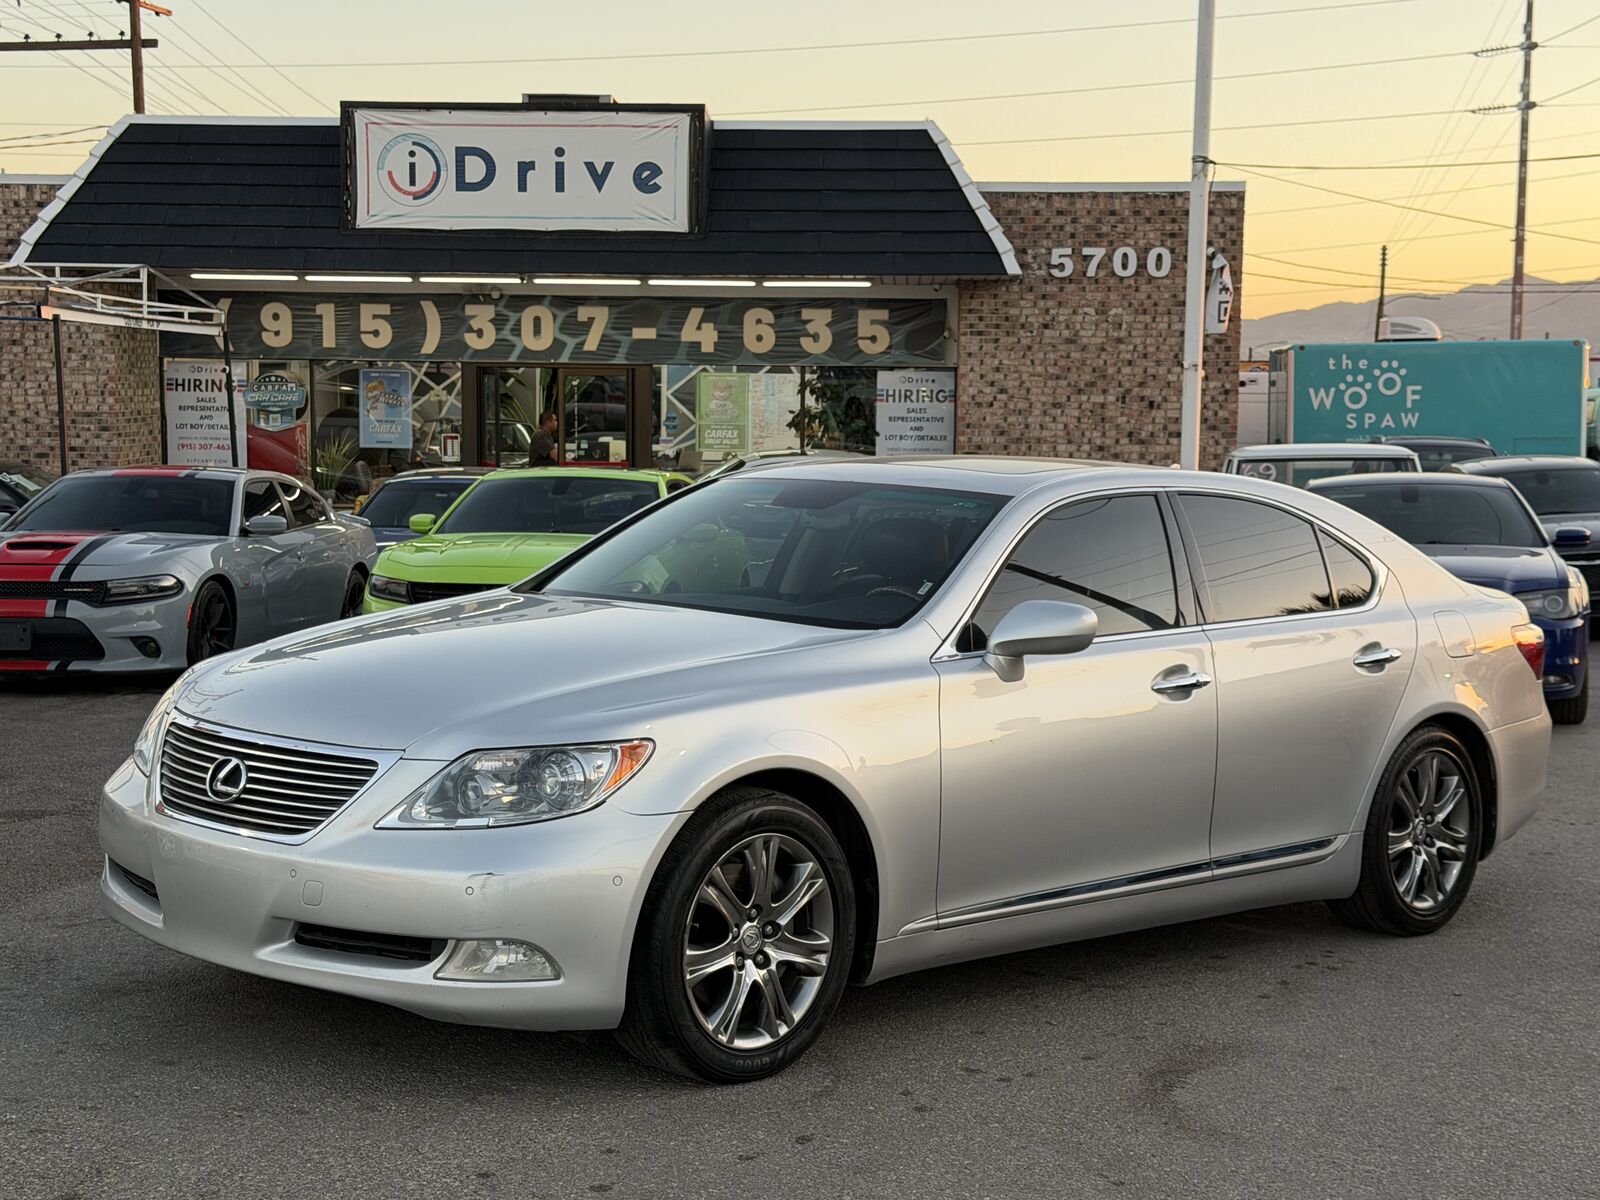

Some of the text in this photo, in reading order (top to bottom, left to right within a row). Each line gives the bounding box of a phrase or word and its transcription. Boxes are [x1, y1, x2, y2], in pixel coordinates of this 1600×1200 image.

[1050, 246, 1172, 278] 5700
[1328, 354, 1369, 370] the
[885, 389, 948, 404] HIRING
[1308, 372, 1422, 410] WOOF
[1346, 412, 1419, 429] SPAW
[704, 430, 739, 439] CARFAX
[198, 443, 231, 451] 307-463
